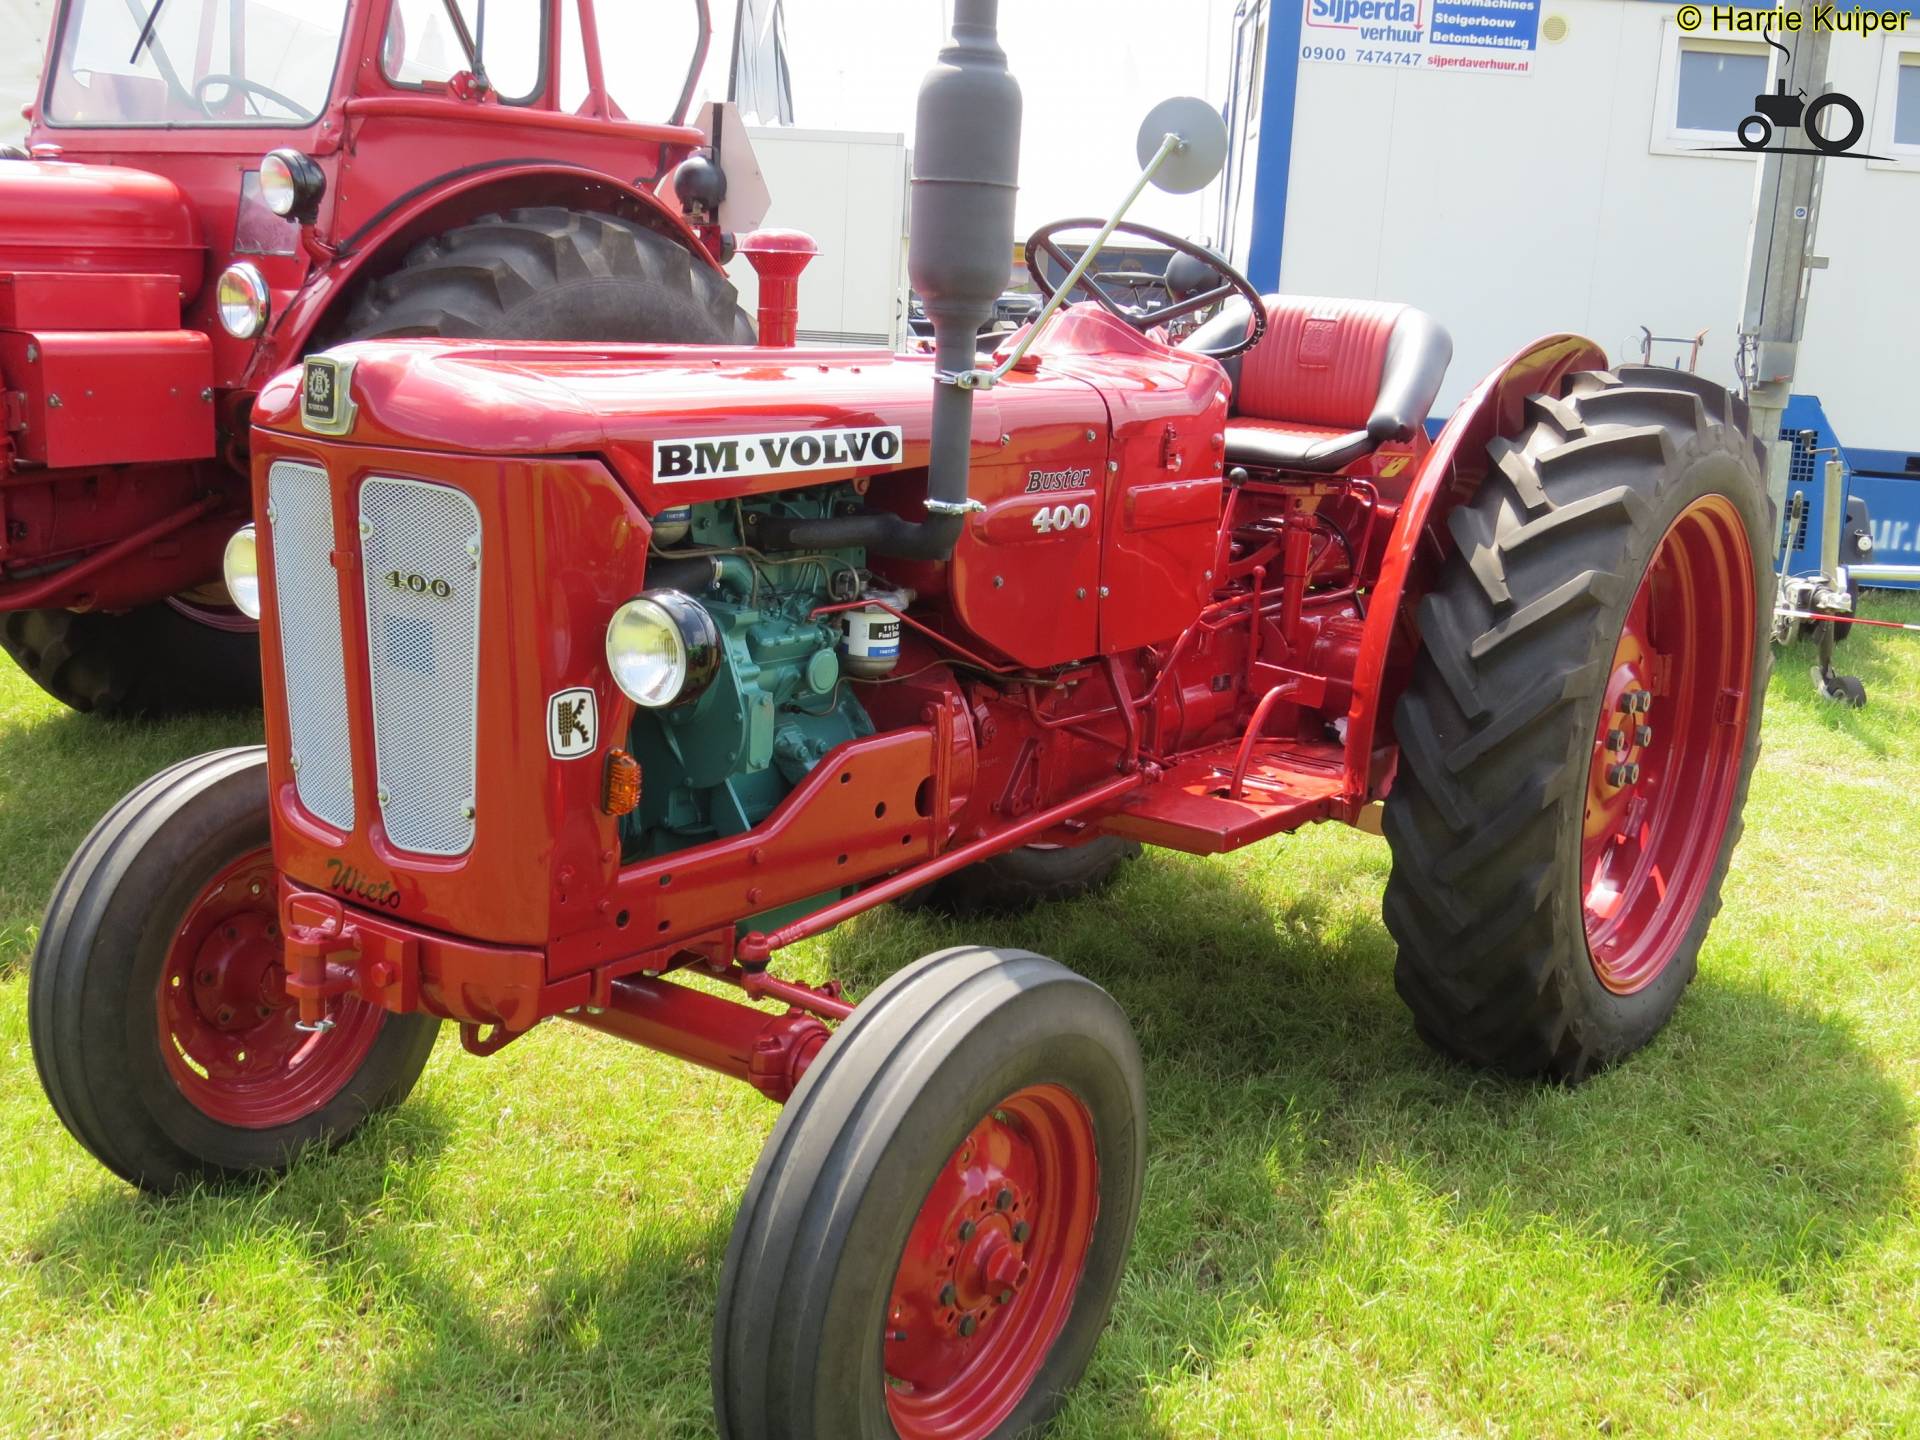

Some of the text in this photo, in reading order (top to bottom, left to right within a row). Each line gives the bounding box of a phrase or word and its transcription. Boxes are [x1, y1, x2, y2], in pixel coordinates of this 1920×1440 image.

[1312, 0, 1415, 23] Sijperda
[1434, 13, 1516, 28] Steigerbouw
[1360, 25, 1424, 43] verhuur
[1432, 31, 1530, 50] Betonbekisting
[1302, 46, 1422, 66] 0900 7474747
[1427, 54, 1529, 71] sijperdaverhuur.nl
[1025, 467, 1091, 493] Buster
[1032, 503, 1091, 533] 400
[1870, 519, 1920, 552] ur.
[384, 569, 452, 598] 400
[326, 858, 401, 909] Wieto
